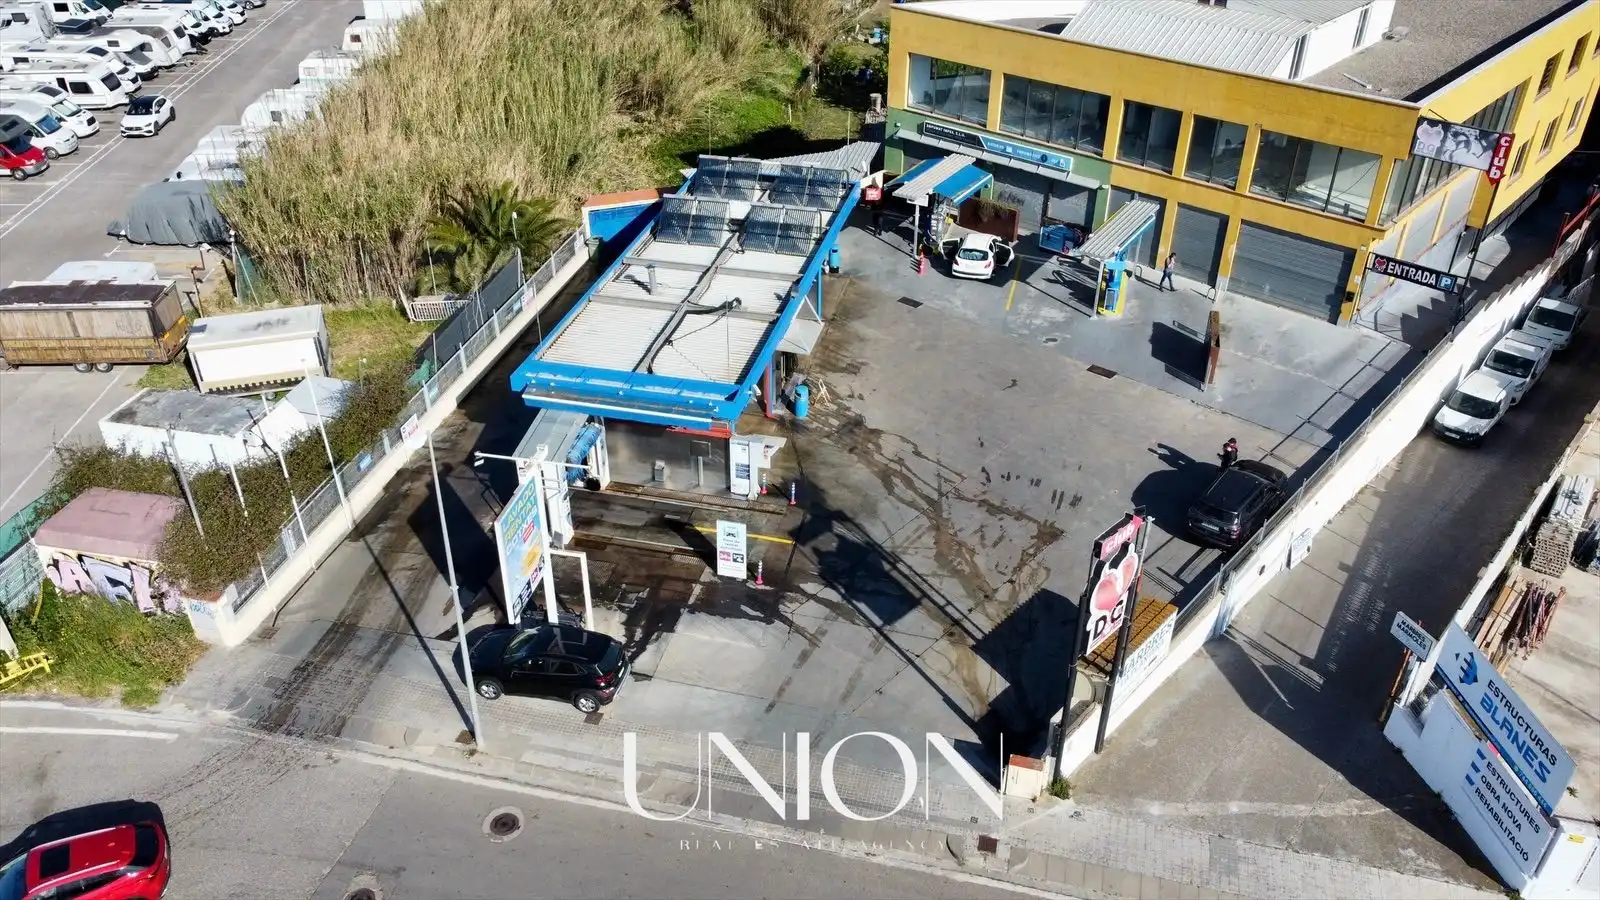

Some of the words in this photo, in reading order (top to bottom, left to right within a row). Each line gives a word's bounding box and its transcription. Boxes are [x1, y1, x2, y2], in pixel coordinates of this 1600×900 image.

[1387, 261, 1437, 286] ENTRADA
[1480, 691, 1552, 784] BLANES
[1488, 679, 1558, 767] ESTRUCTURAS
[1474, 786, 1530, 863] REHABILITACIÓ
[1480, 774, 1502, 805] OBRA
[1501, 801, 1523, 833] NOVA
[1486, 760, 1541, 835] ESTRUCTURES
